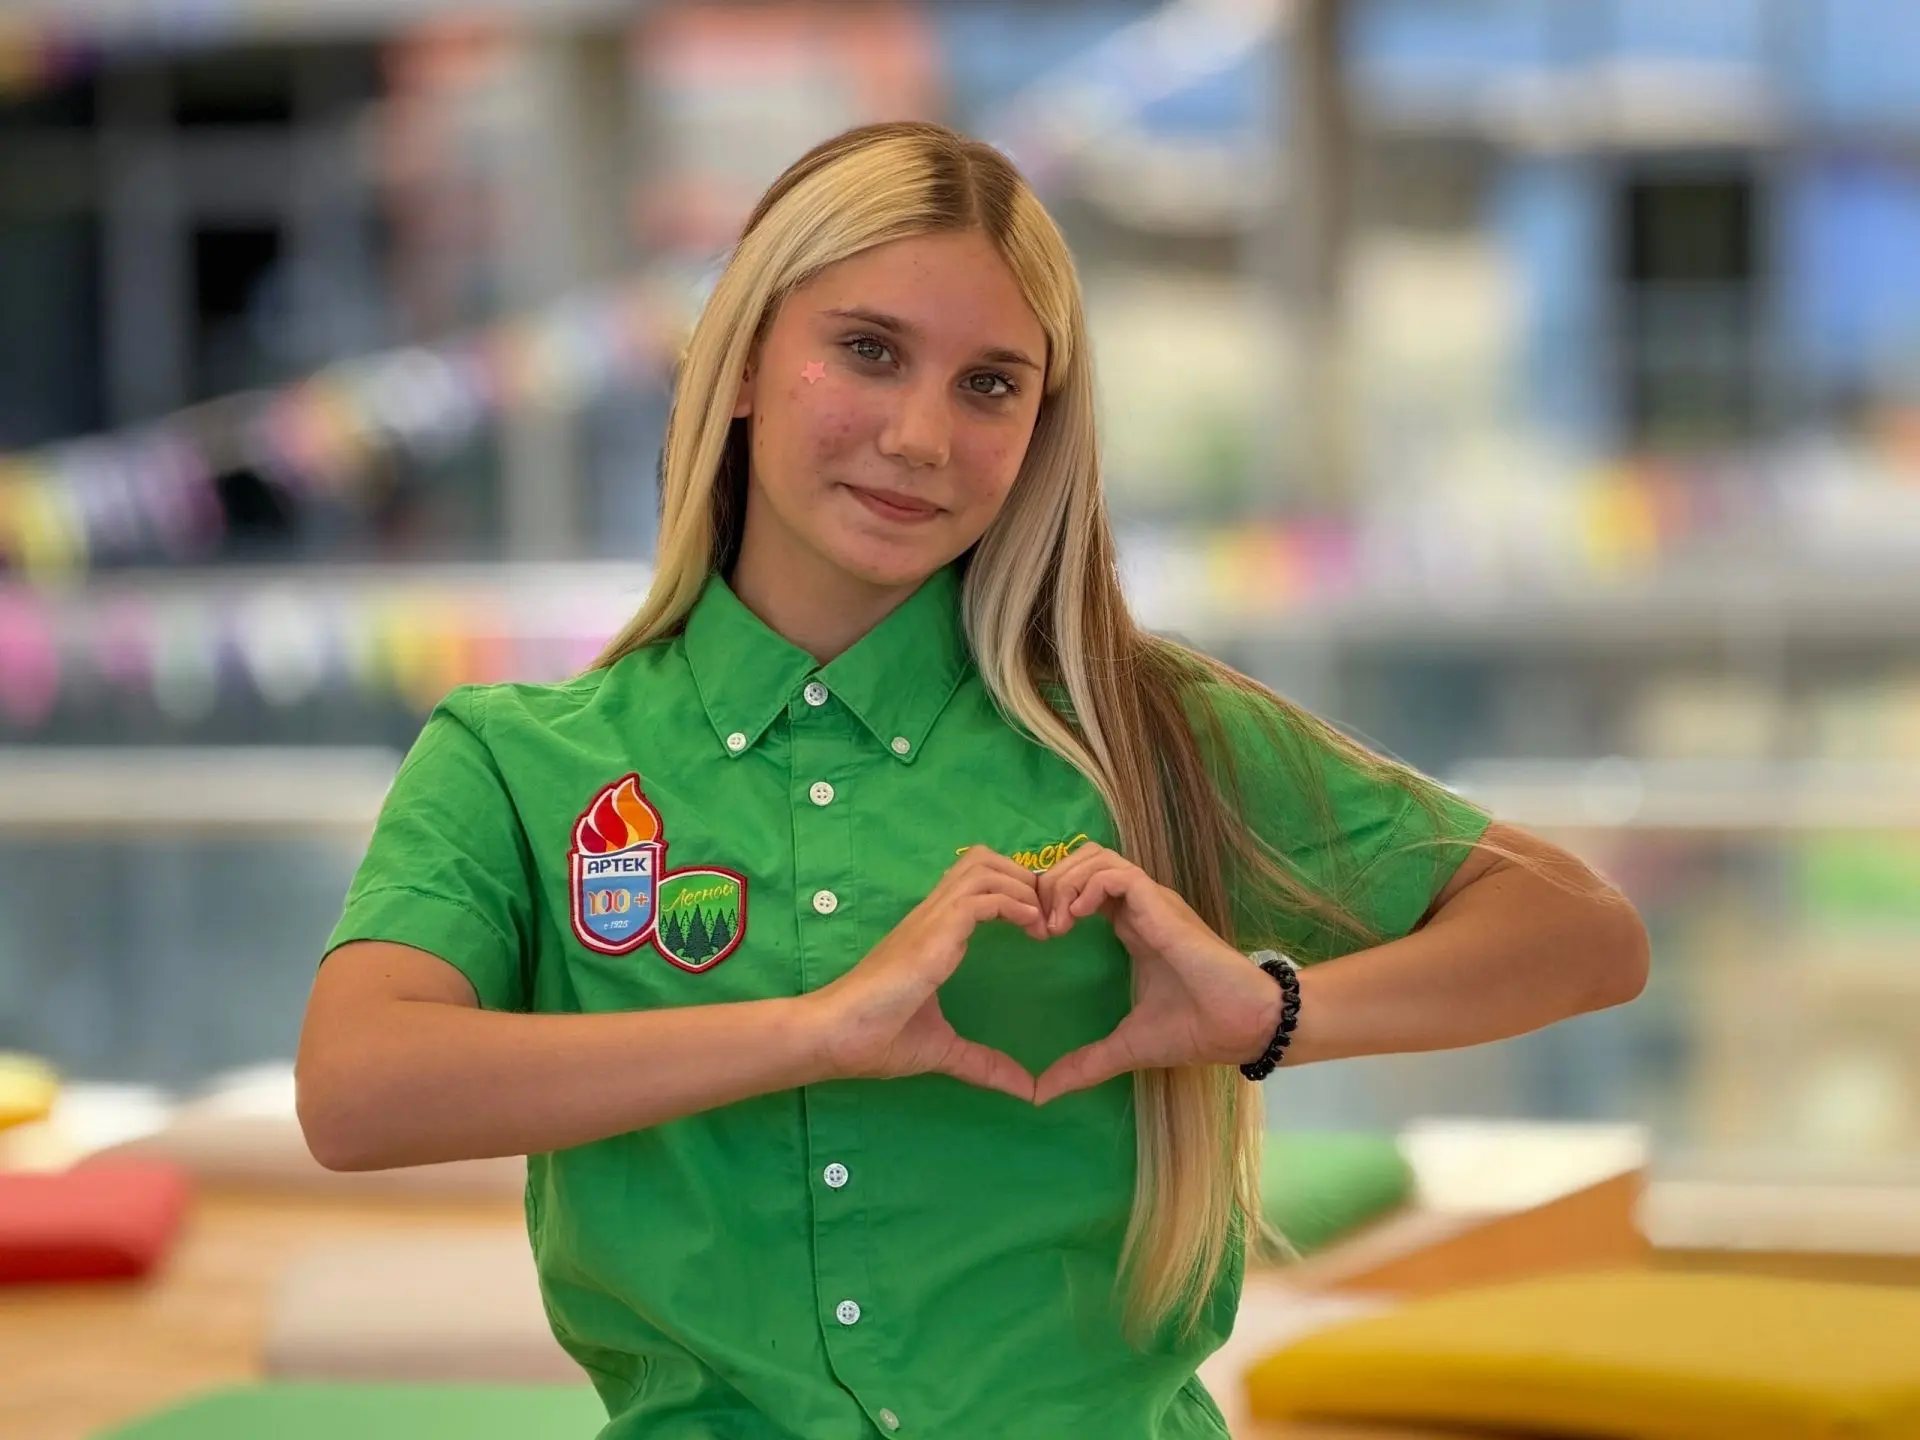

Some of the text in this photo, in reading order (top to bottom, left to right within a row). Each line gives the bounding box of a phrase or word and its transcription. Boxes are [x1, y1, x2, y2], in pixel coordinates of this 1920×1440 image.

[587, 858, 647, 874] АРТЕК
[956, 833, 1088, 871] тек
[662, 881, 735, 912] Лесной
